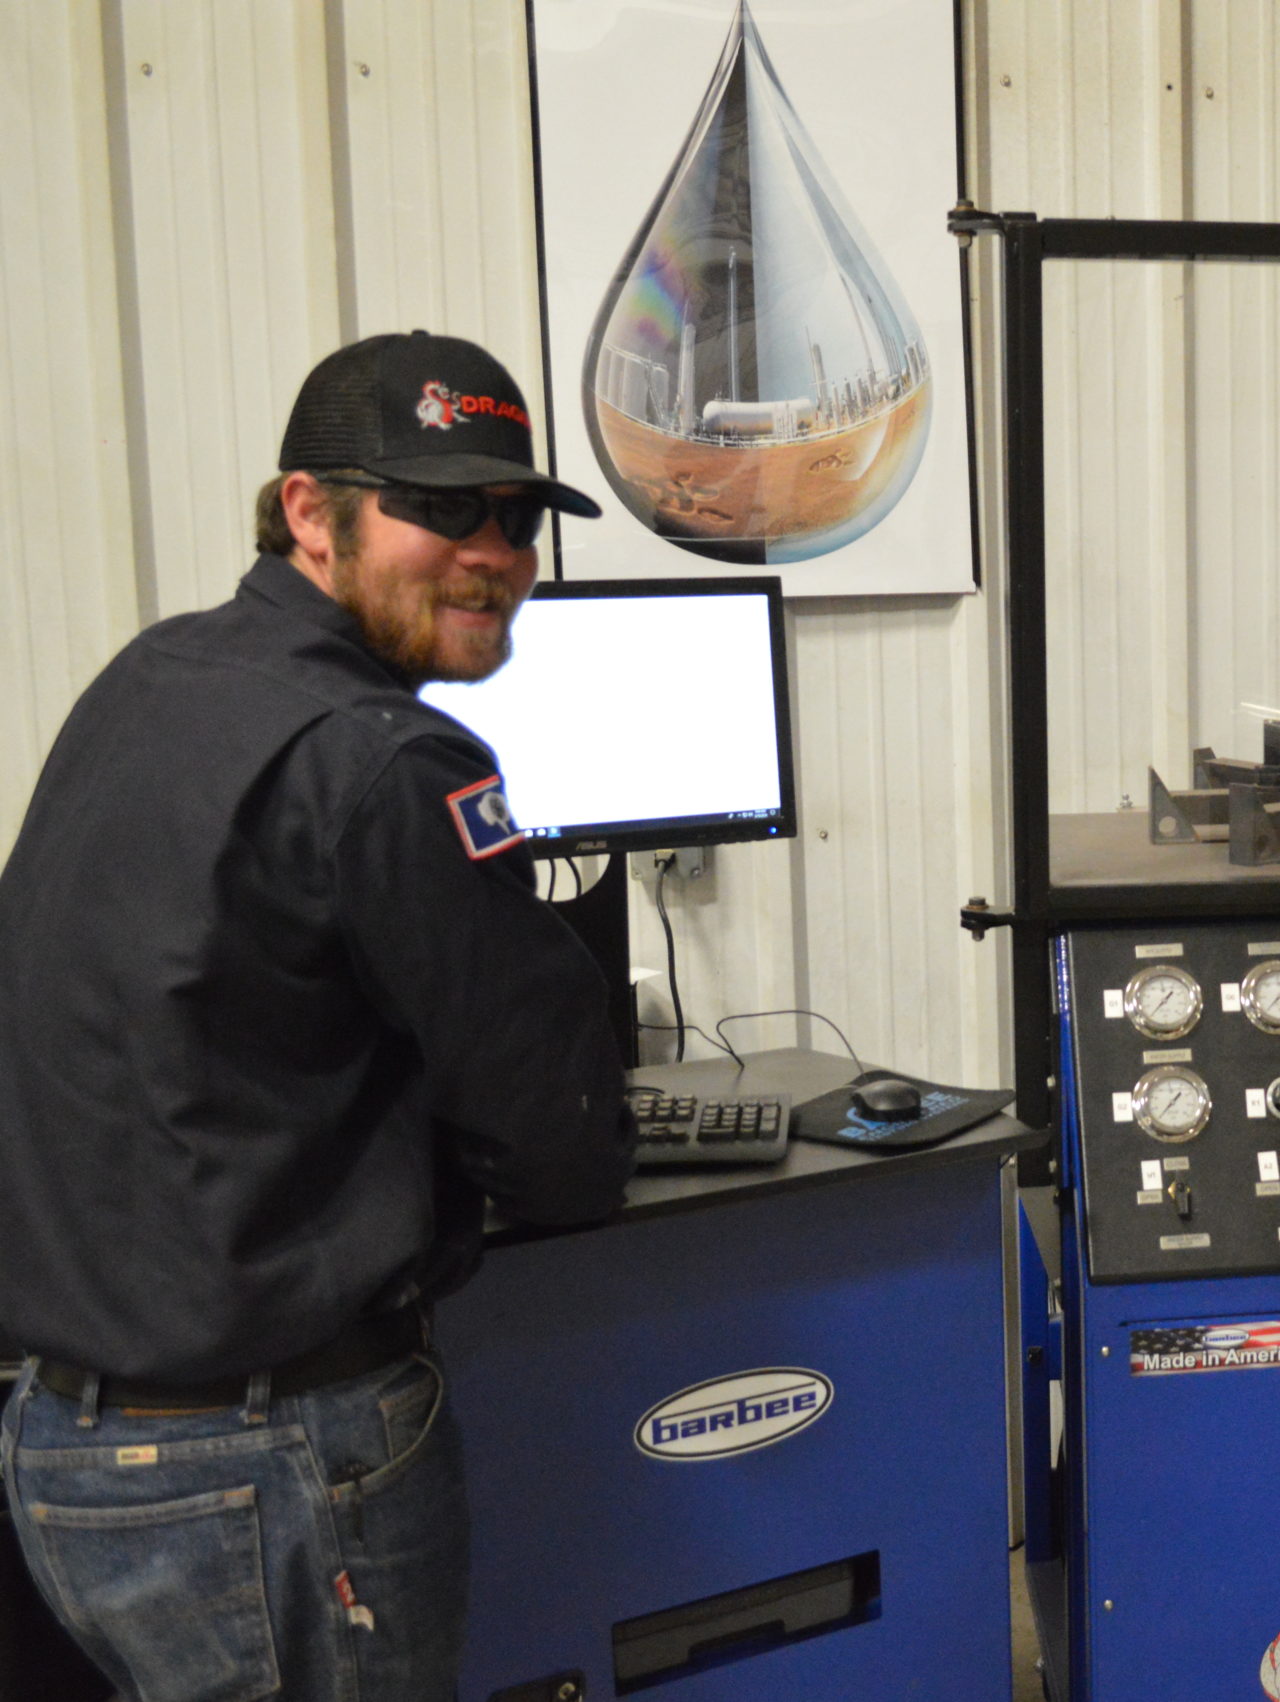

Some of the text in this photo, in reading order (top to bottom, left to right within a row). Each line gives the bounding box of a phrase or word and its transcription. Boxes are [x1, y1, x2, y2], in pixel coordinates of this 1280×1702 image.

[1143, 1351, 1196, 1370] Made
[1202, 1351, 1220, 1366] in
[652, 1391, 817, 1446] barbee
